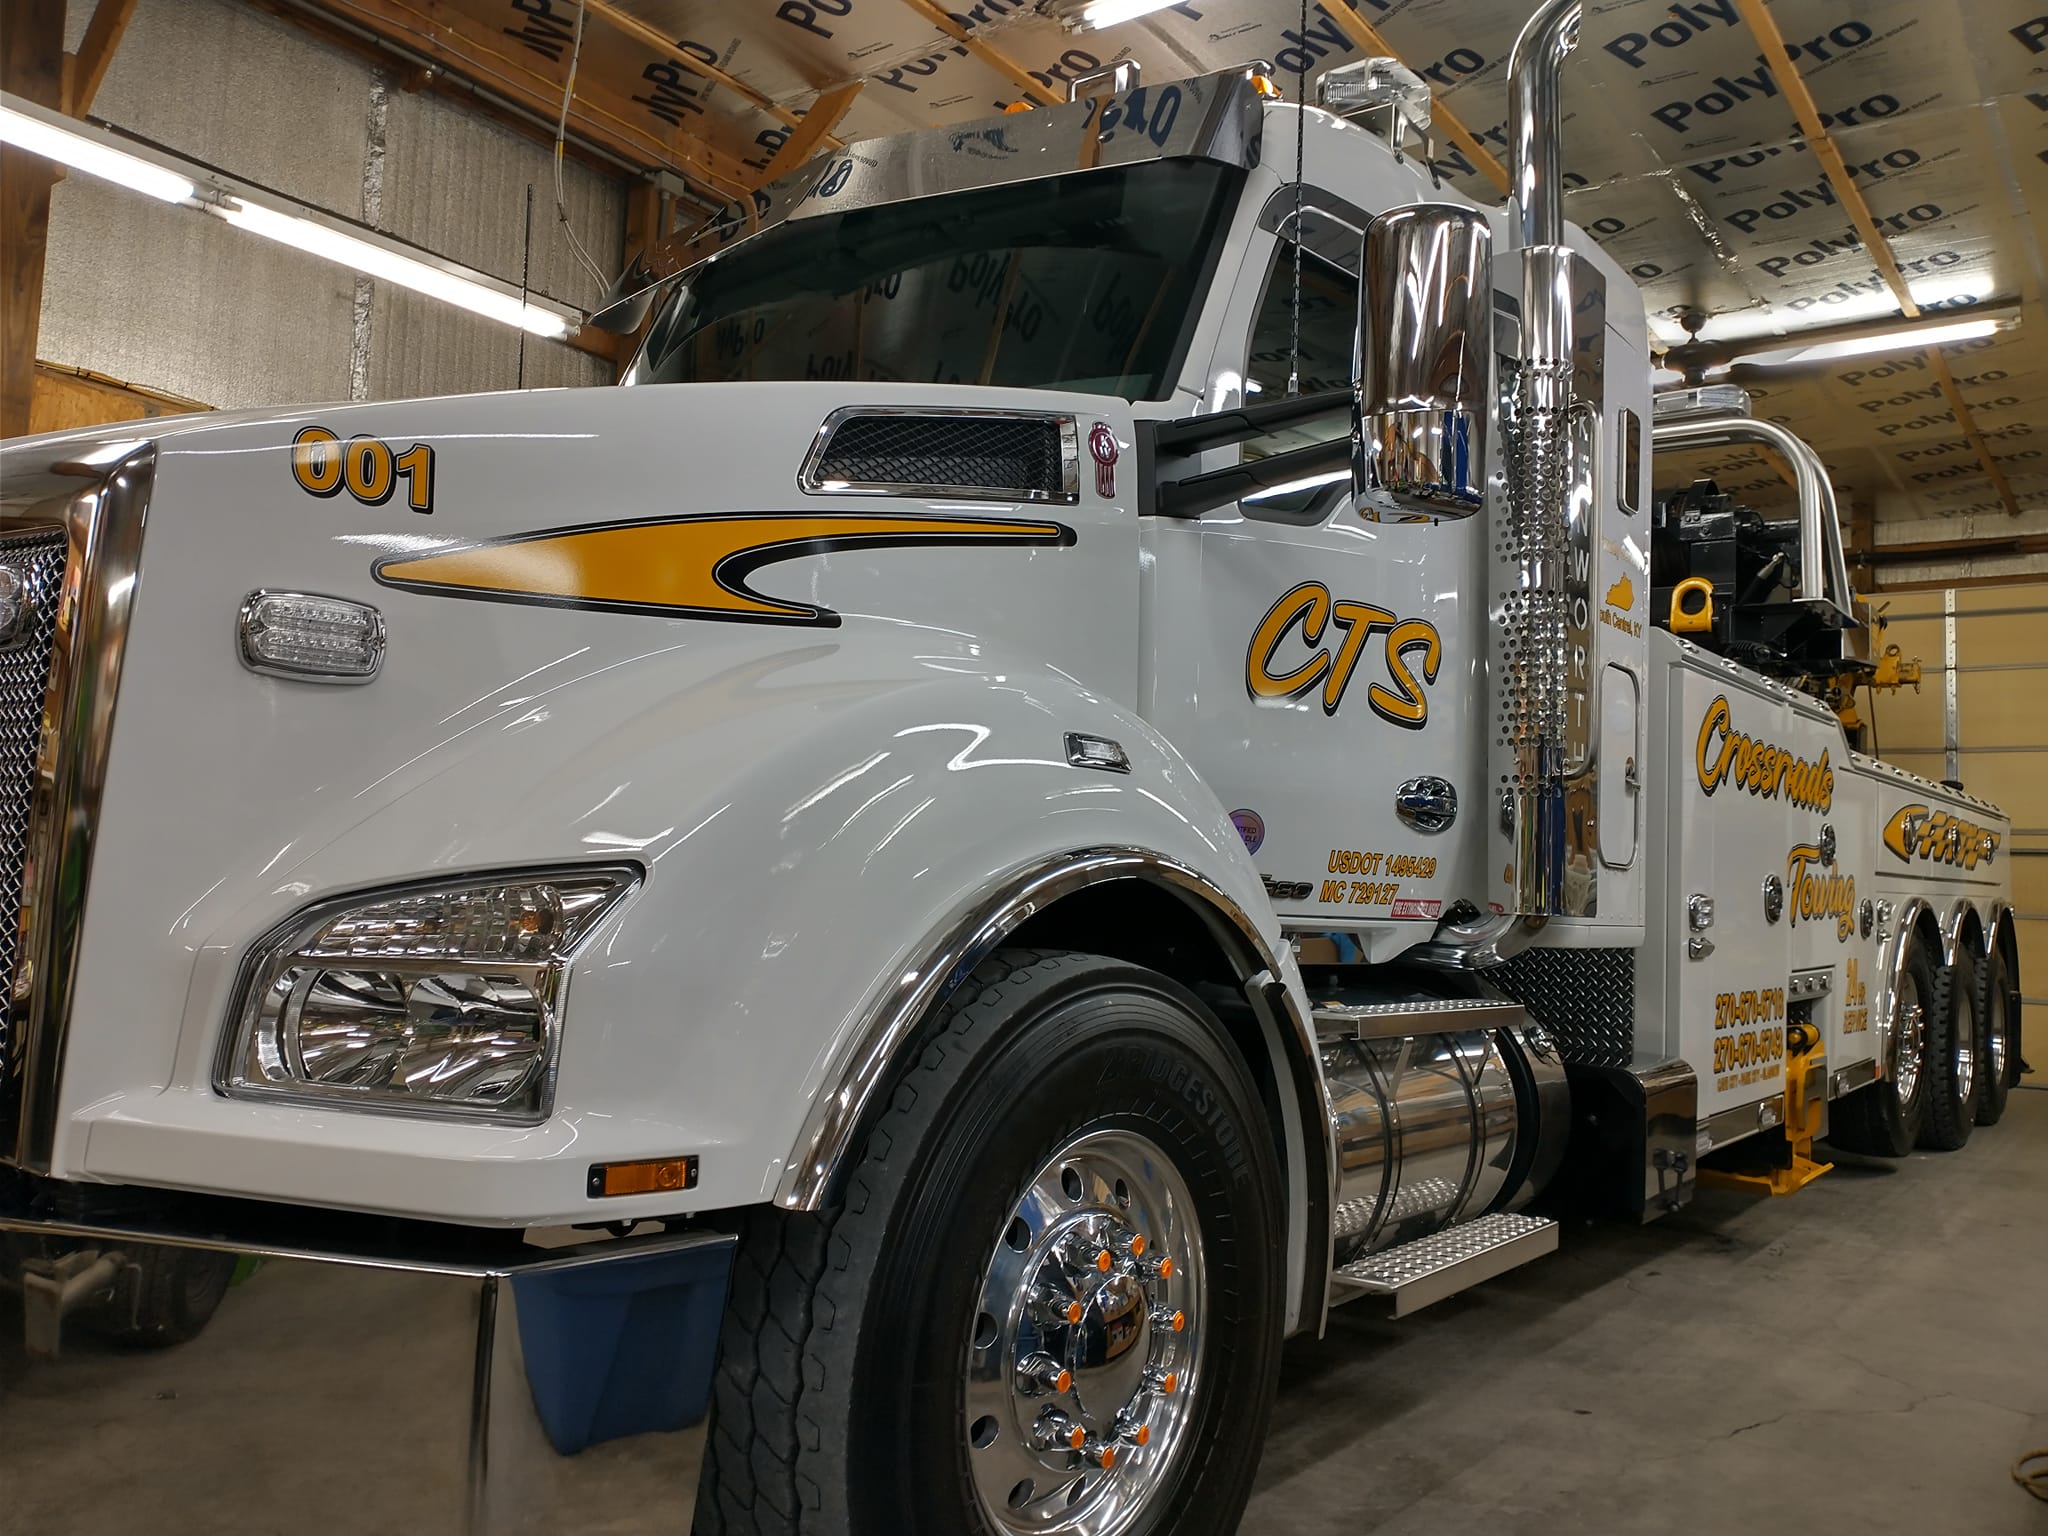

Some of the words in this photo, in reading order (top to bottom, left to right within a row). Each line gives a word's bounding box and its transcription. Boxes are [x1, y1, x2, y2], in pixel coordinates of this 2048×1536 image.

[1603, 0, 1740, 69] Poly
[291, 425, 435, 515] 001
[1245, 580, 1442, 731] CTS
[1696, 694, 1834, 816] Crossroads
[1319, 880, 1346, 903] MC
[1349, 881, 1399, 905] 729127
[1327, 850, 1383, 875] USDOT
[1384, 854, 1437, 879] 1495429
[1786, 843, 1855, 942] Towing
